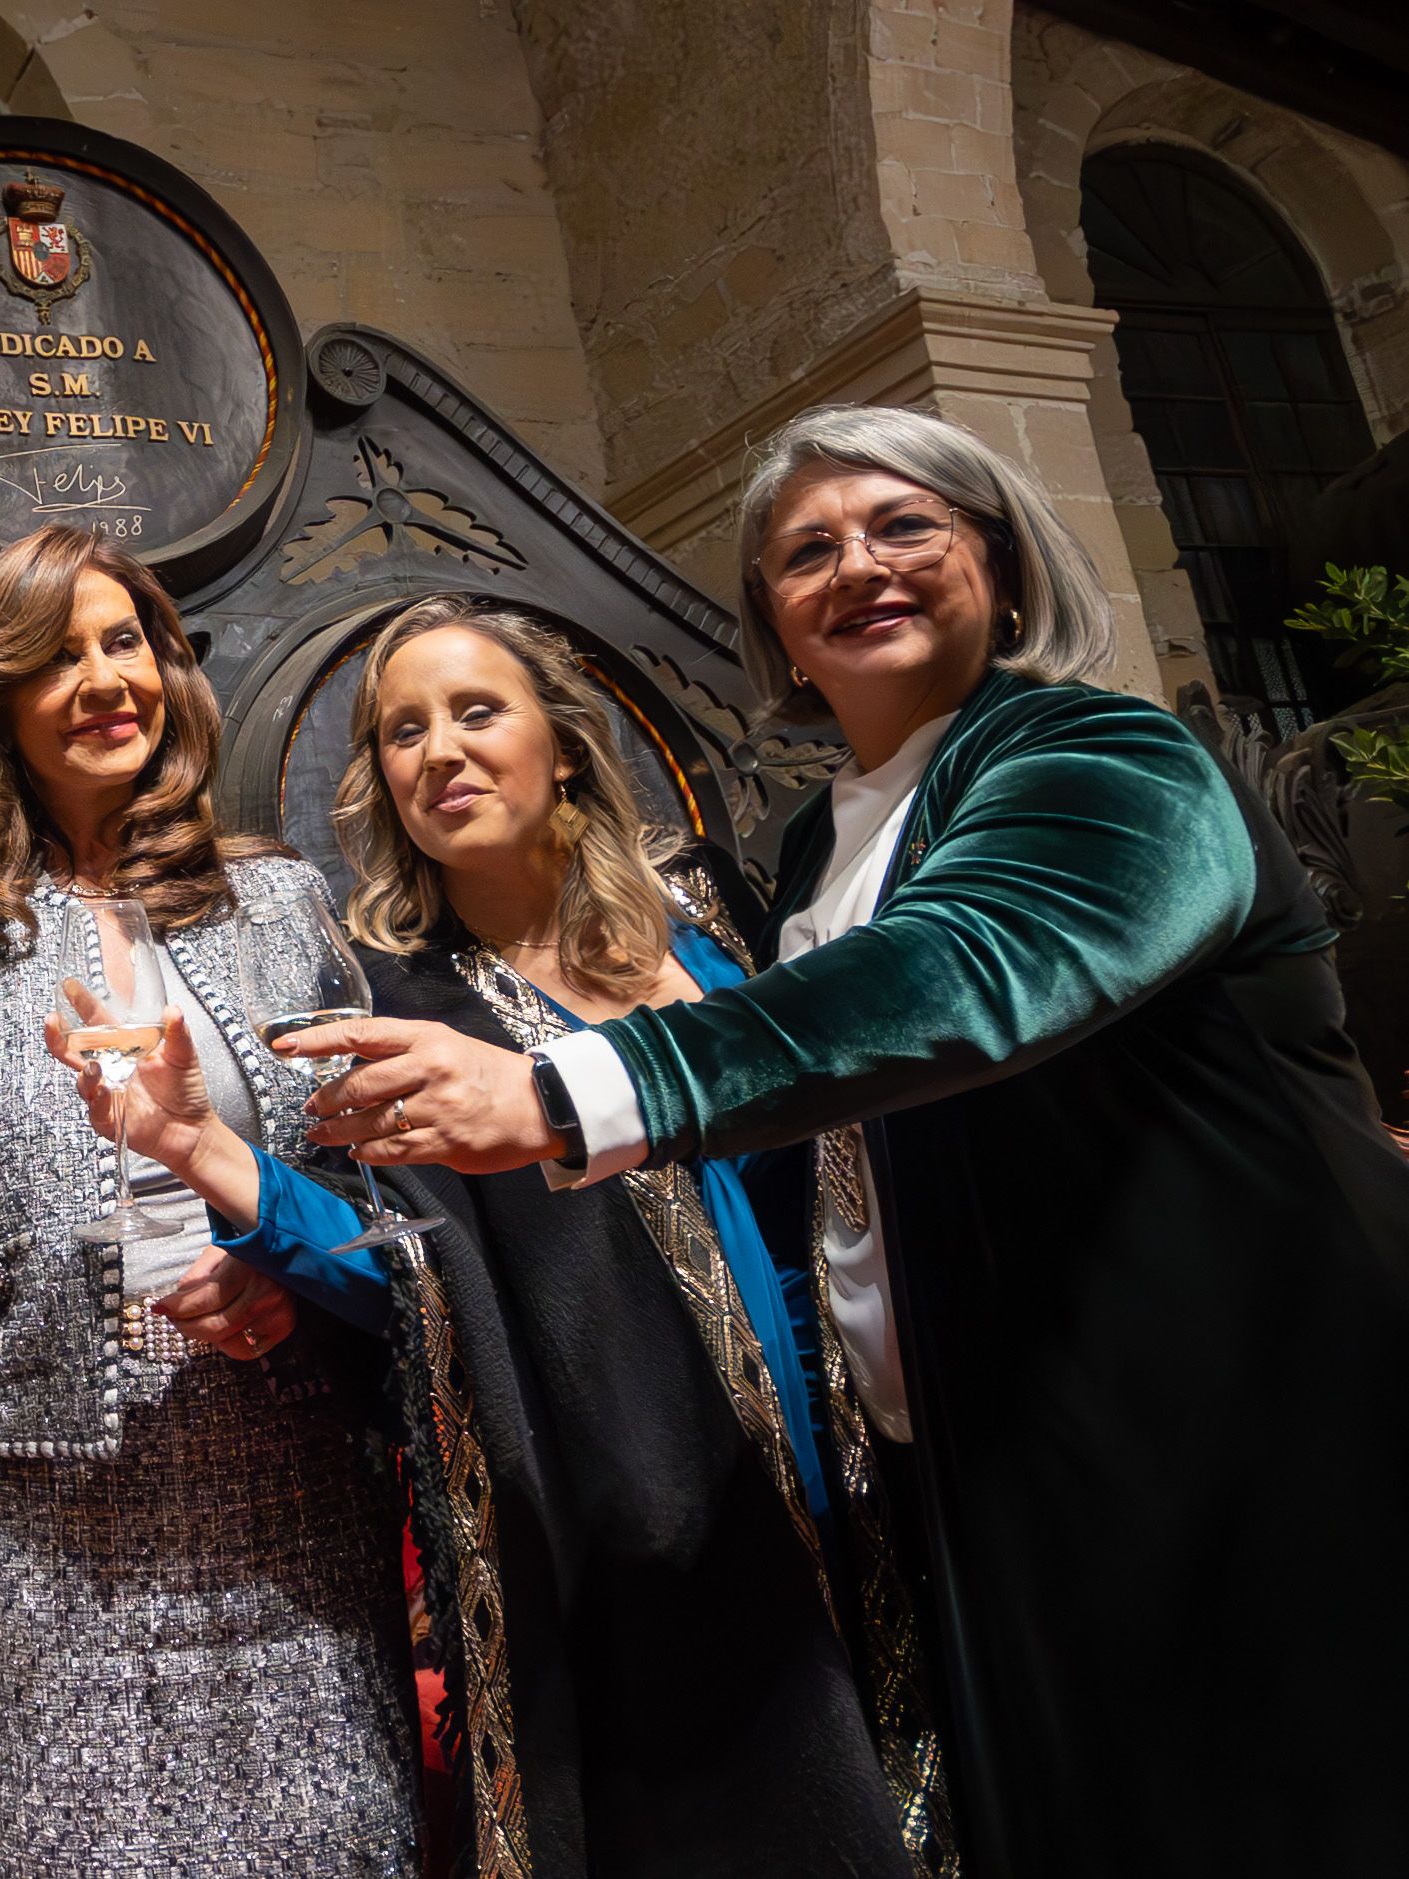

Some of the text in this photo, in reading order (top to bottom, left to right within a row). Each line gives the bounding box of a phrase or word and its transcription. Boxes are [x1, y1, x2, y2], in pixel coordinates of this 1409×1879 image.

[133, 339, 157, 363] A
[29, 373, 101, 398] S.M.
[45, 413, 170, 442] FELIPE
[177, 420, 215, 446] VI
